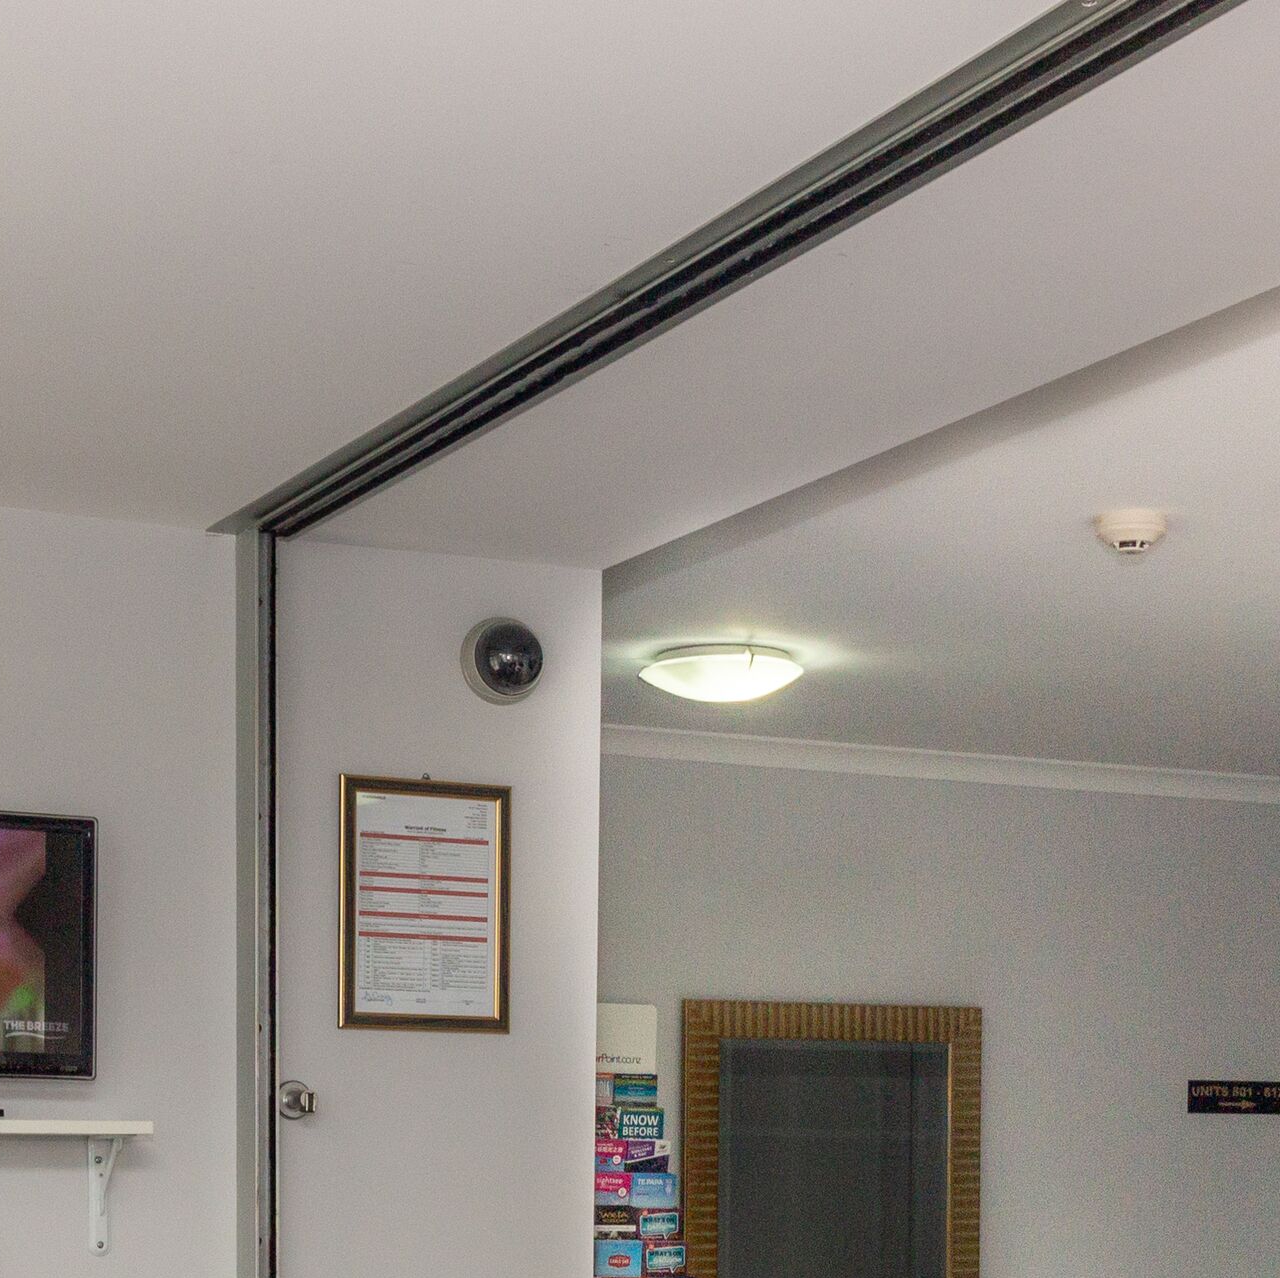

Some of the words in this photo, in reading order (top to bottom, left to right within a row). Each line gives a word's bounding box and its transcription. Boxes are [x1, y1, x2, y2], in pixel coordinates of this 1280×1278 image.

[3, 1019, 26, 1031] THE
[26, 1021, 70, 1032] BREEZE
[1191, 1085, 1229, 1097] UNITS
[622, 1114, 659, 1126] KNOW
[622, 1126, 660, 1136] BEFORE
